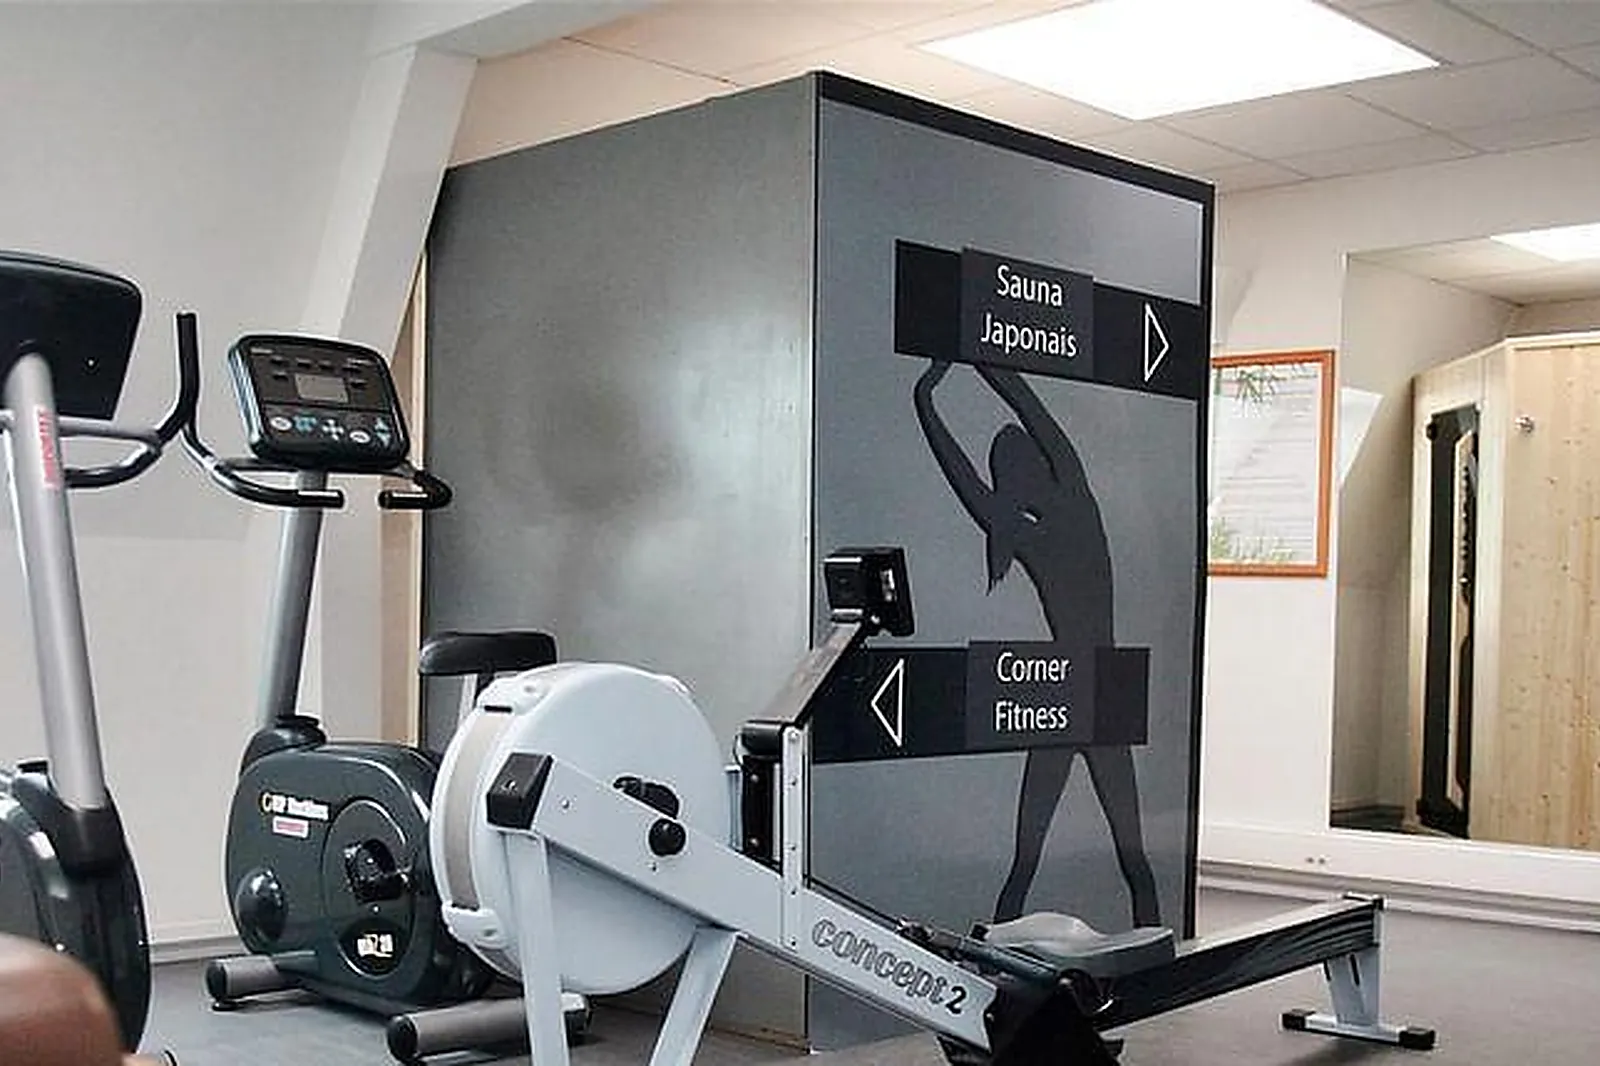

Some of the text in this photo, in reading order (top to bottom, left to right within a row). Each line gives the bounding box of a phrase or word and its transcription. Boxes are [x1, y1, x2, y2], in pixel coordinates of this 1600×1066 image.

[997, 264, 1062, 306] Sauna
[981, 313, 1077, 357] Japonais
[997, 652, 1069, 682] Corner
[996, 701, 1068, 730] Fitness
